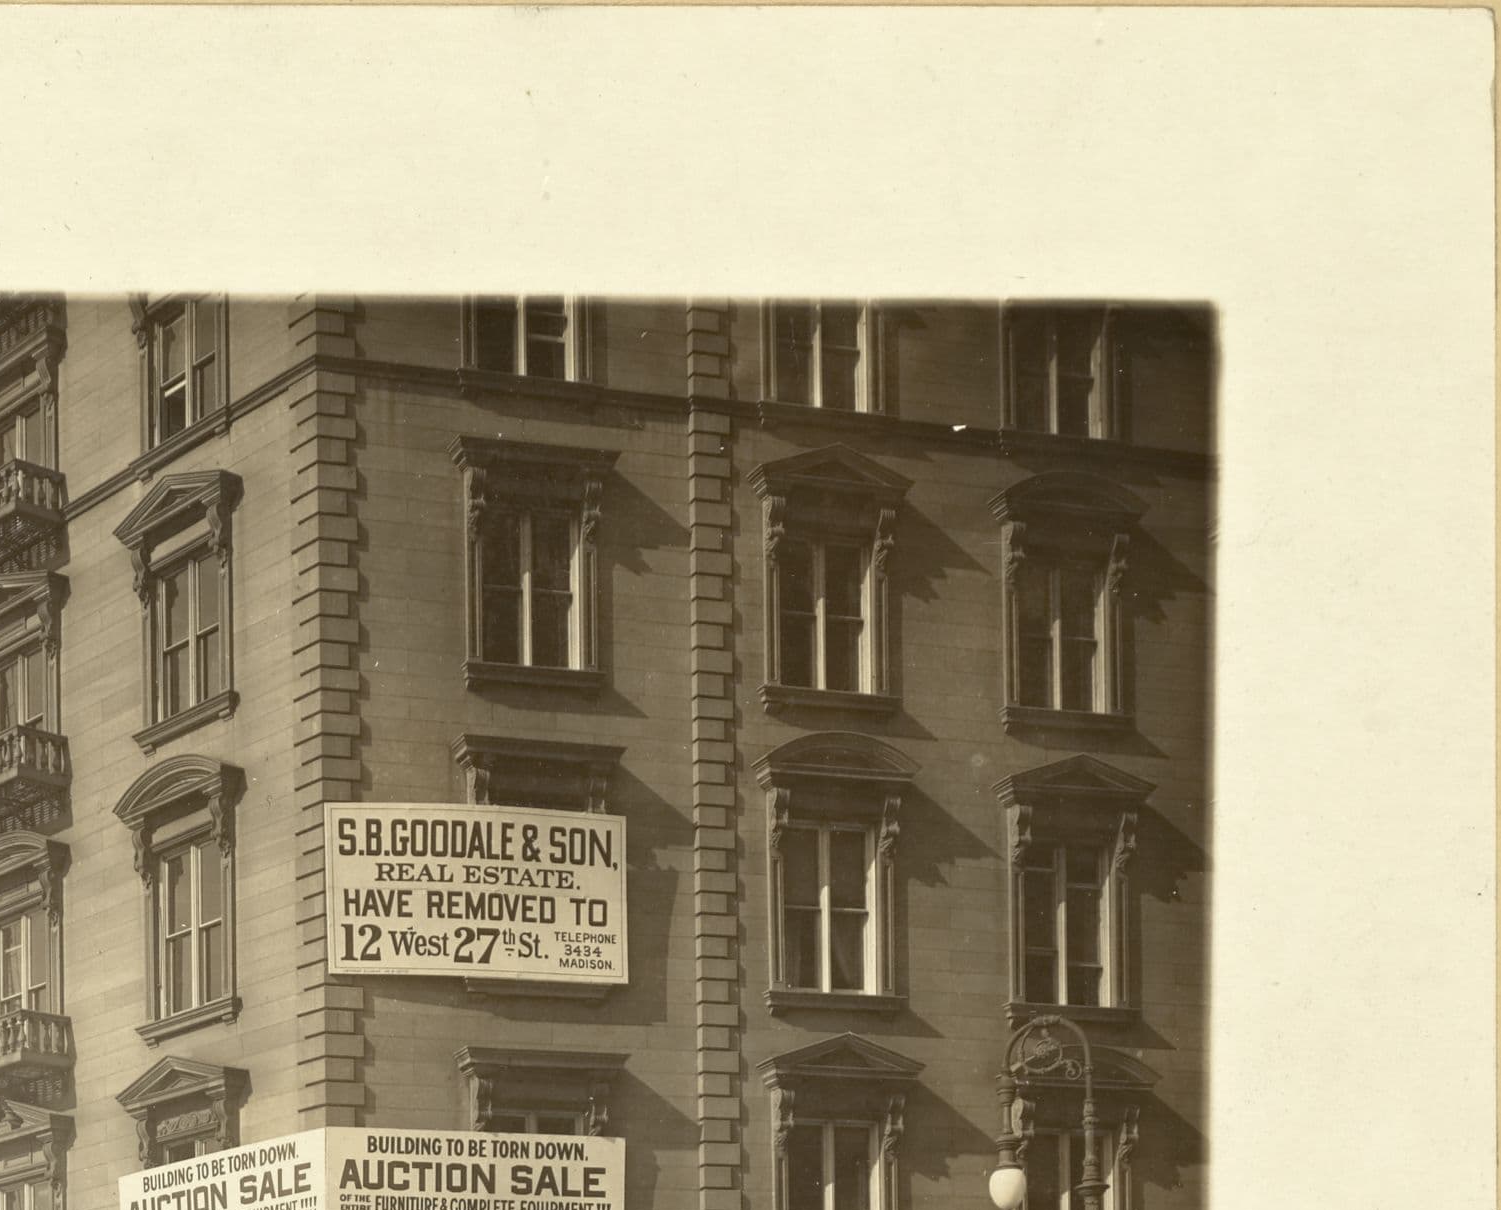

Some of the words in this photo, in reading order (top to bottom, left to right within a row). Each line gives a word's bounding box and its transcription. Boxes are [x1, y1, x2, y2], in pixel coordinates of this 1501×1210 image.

[522, 824, 541, 862] &
[550, 827, 618, 871] SON,
[375, 863, 453, 883] REAL
[463, 865, 581, 890] ESTATE.
[343, 888, 413, 917] HAVE
[427, 891, 556, 924] REMOVED
[569, 898, 607, 927] TO
[340, 924, 382, 961] 12
[388, 929, 449, 956] West
[517, 932, 549, 959] St.
[554, 931, 617, 945] TELEPHONE
[564, 944, 602, 957] 3434
[559, 958, 616, 971] MADISON.
[367, 1135, 442, 1156] BUILDING
[446, 1138, 464, 1156] TO
[468, 1139, 487, 1157] BE
[491, 1140, 530, 1159] TORN
[535, 1141, 589, 1161] DOWN.
[143, 1166, 193, 1193] BUILDING
[196, 1163, 209, 1181] TO
[212, 1158, 225, 1178] BE
[228, 1151, 256, 1174] TORN
[259, 1142, 299, 1166] DOWN.
[239, 1162, 311, 1205] SALE
[339, 1159, 496, 1194] AUCTION
[510, 1165, 606, 1198] SALE
[339, 1194, 353, 1202] OF
[354, 1195, 371, 1203] THE
